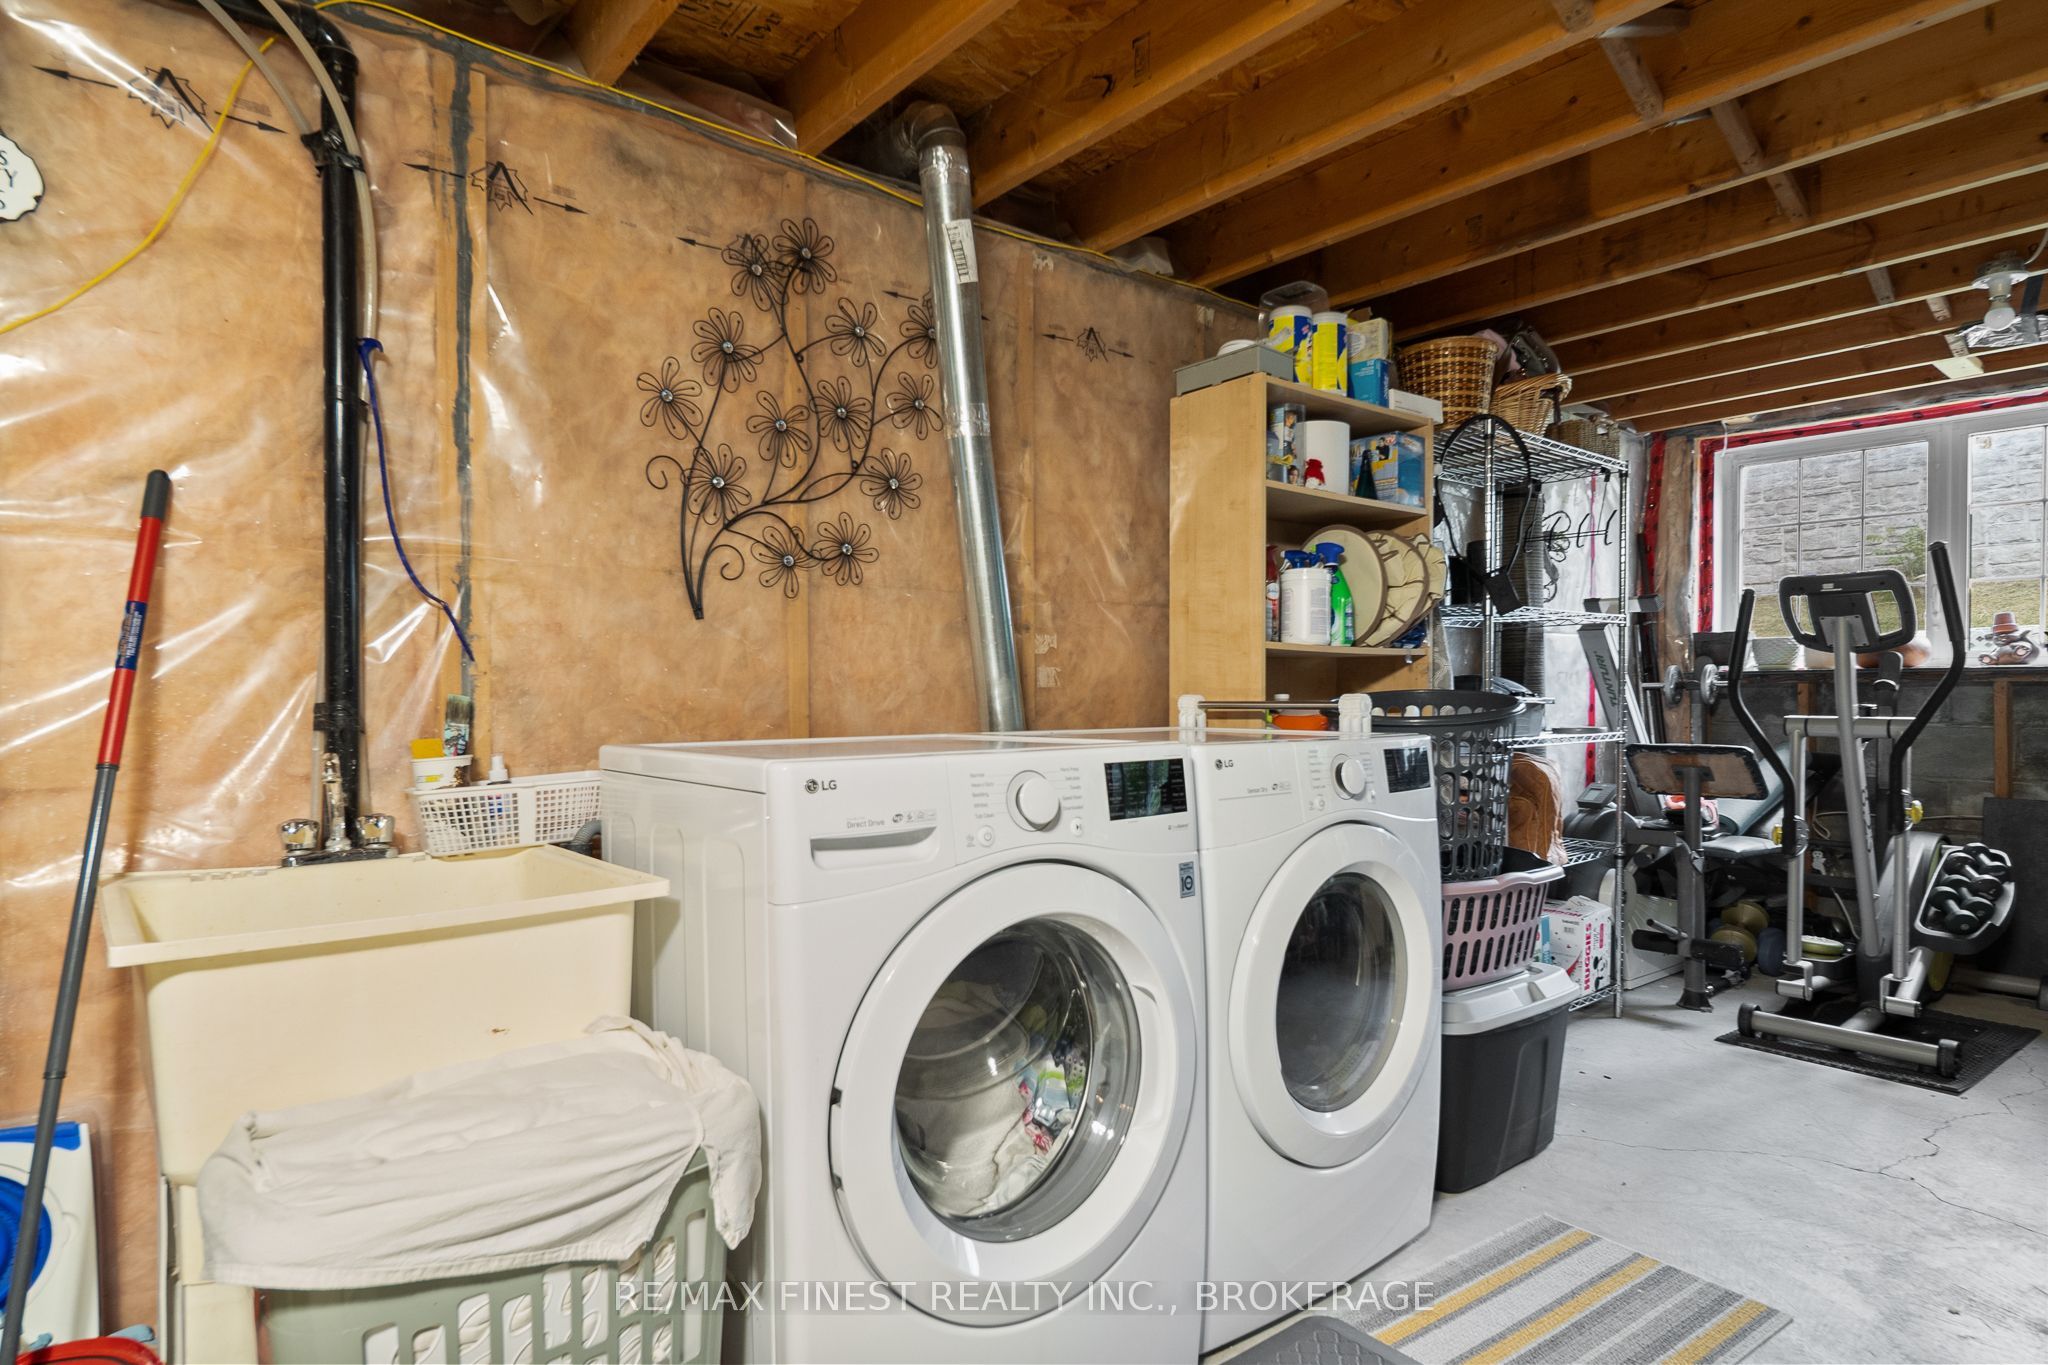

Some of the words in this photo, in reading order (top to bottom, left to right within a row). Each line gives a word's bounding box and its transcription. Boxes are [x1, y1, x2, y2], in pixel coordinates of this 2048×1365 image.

[821, 780, 837, 791] LG
[847, 820, 867, 829] Direct
[868, 819, 885, 827] Drive
[1584, 923, 1592, 991] HUGGIES
